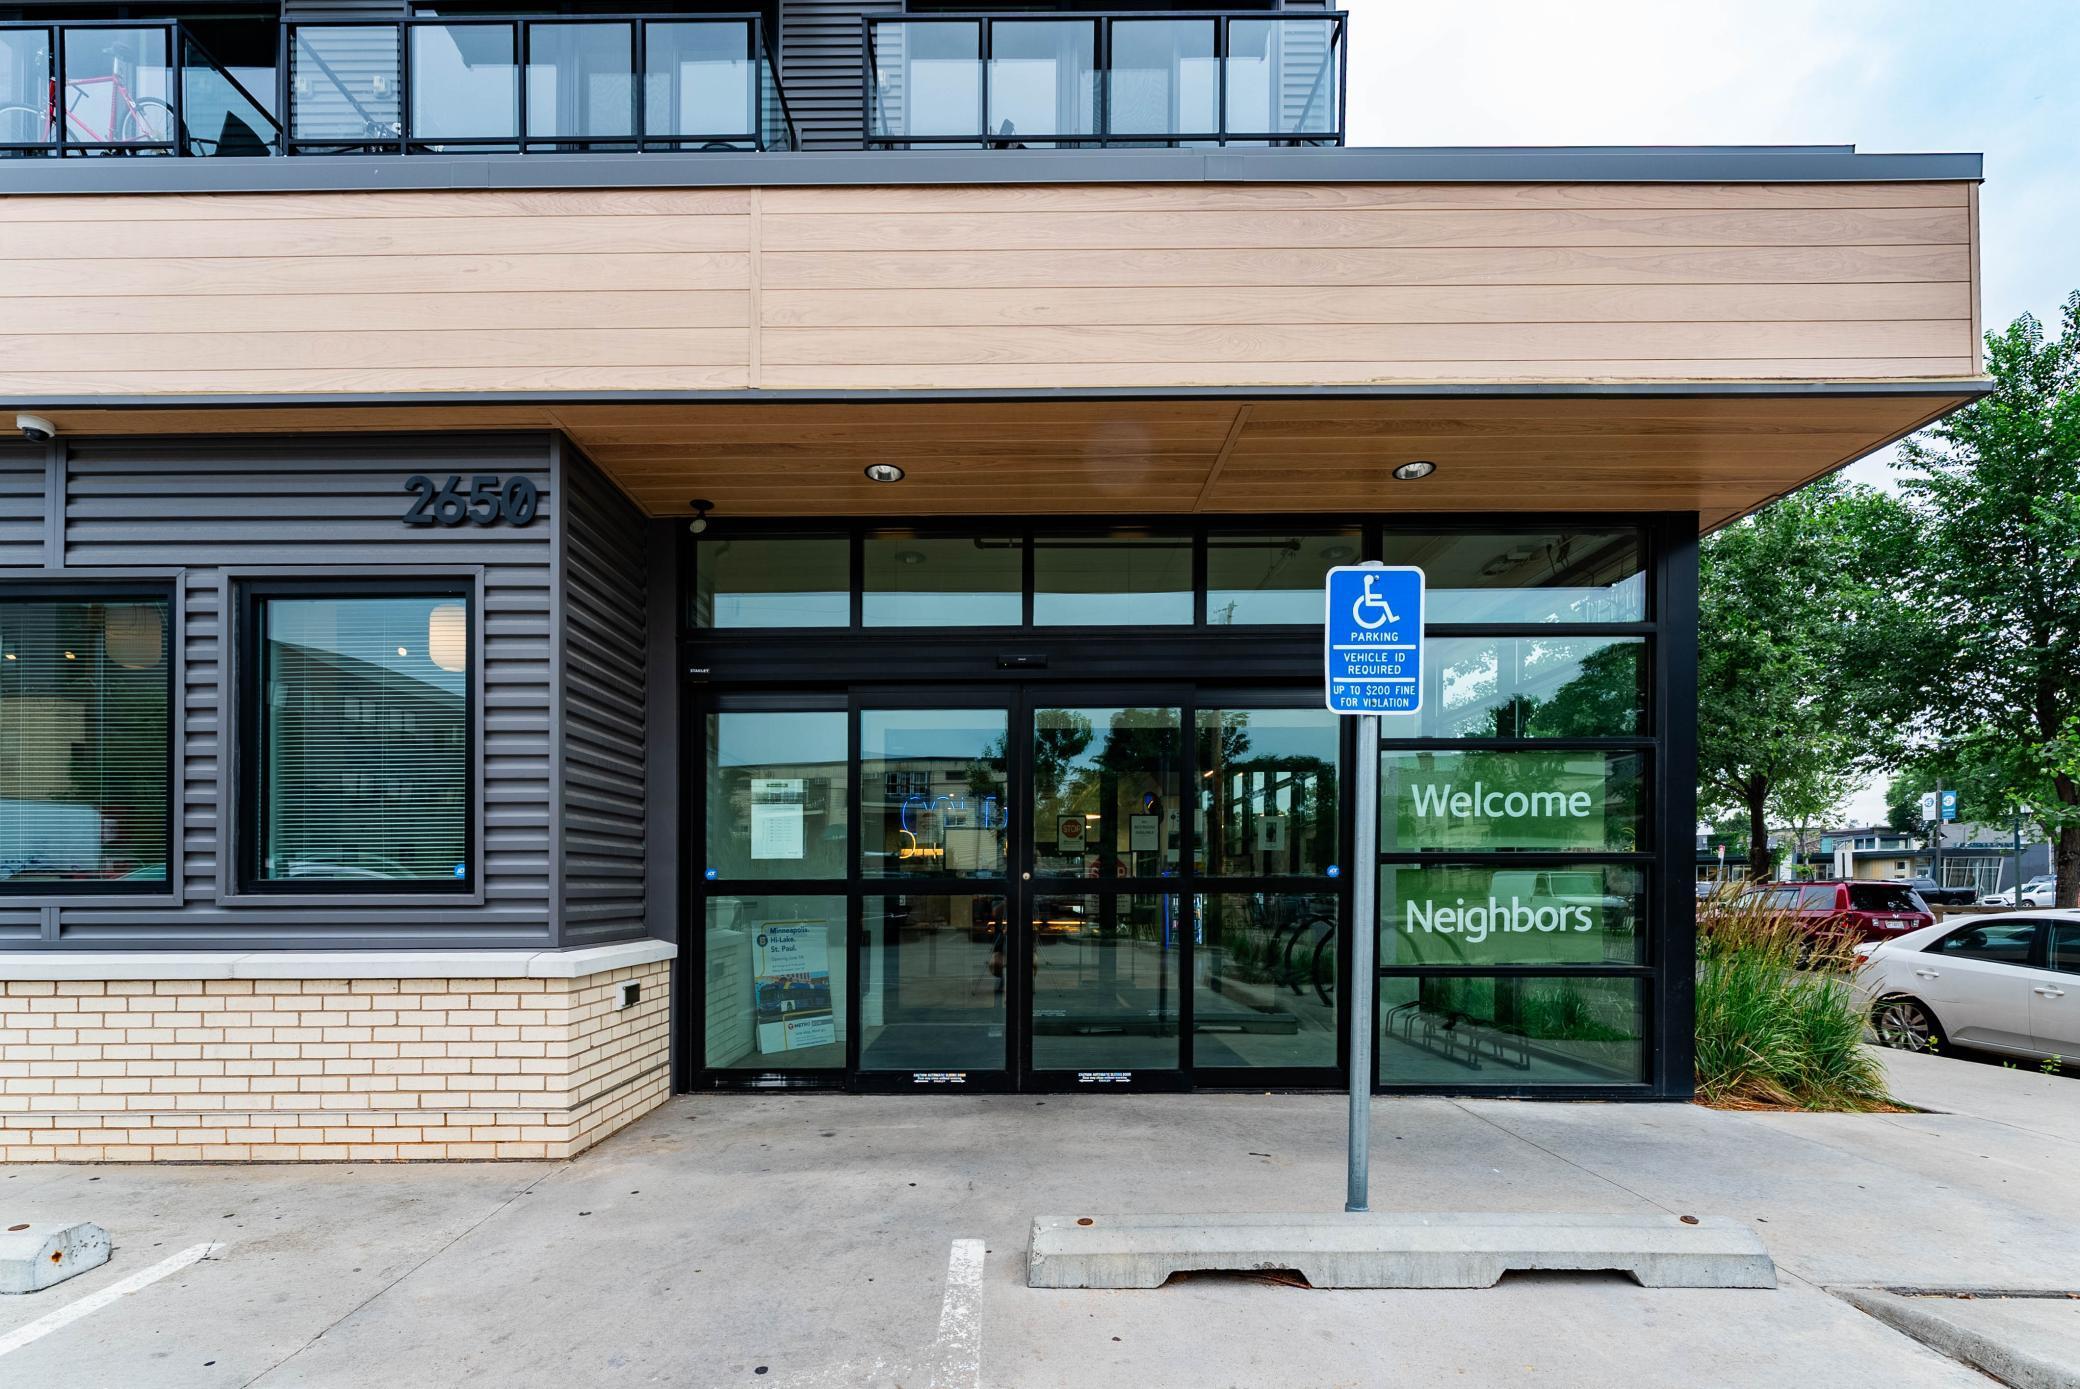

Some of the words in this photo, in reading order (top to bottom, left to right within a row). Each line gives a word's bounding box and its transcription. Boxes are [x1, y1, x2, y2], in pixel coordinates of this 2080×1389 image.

[403, 475, 538, 525] 2650
[1351, 632, 1399, 642] PARKING
[1344, 652, 1388, 662] VEHICLE
[1395, 652, 1406, 662] ID
[1348, 665, 1401, 675] REQUIRED
[1333, 685, 1345, 695] UP
[1350, 685, 1360, 695] TO
[1366, 685, 1390, 695] $200
[1395, 685, 1415, 695] FINE
[1340, 698, 1358, 707] FOR
[1363, 698, 1409, 708] VIOLATION
[1411, 782, 1592, 818] Welcome
[1063, 824, 1081, 833] STOP
[1406, 896, 1593, 943] Neighbors
